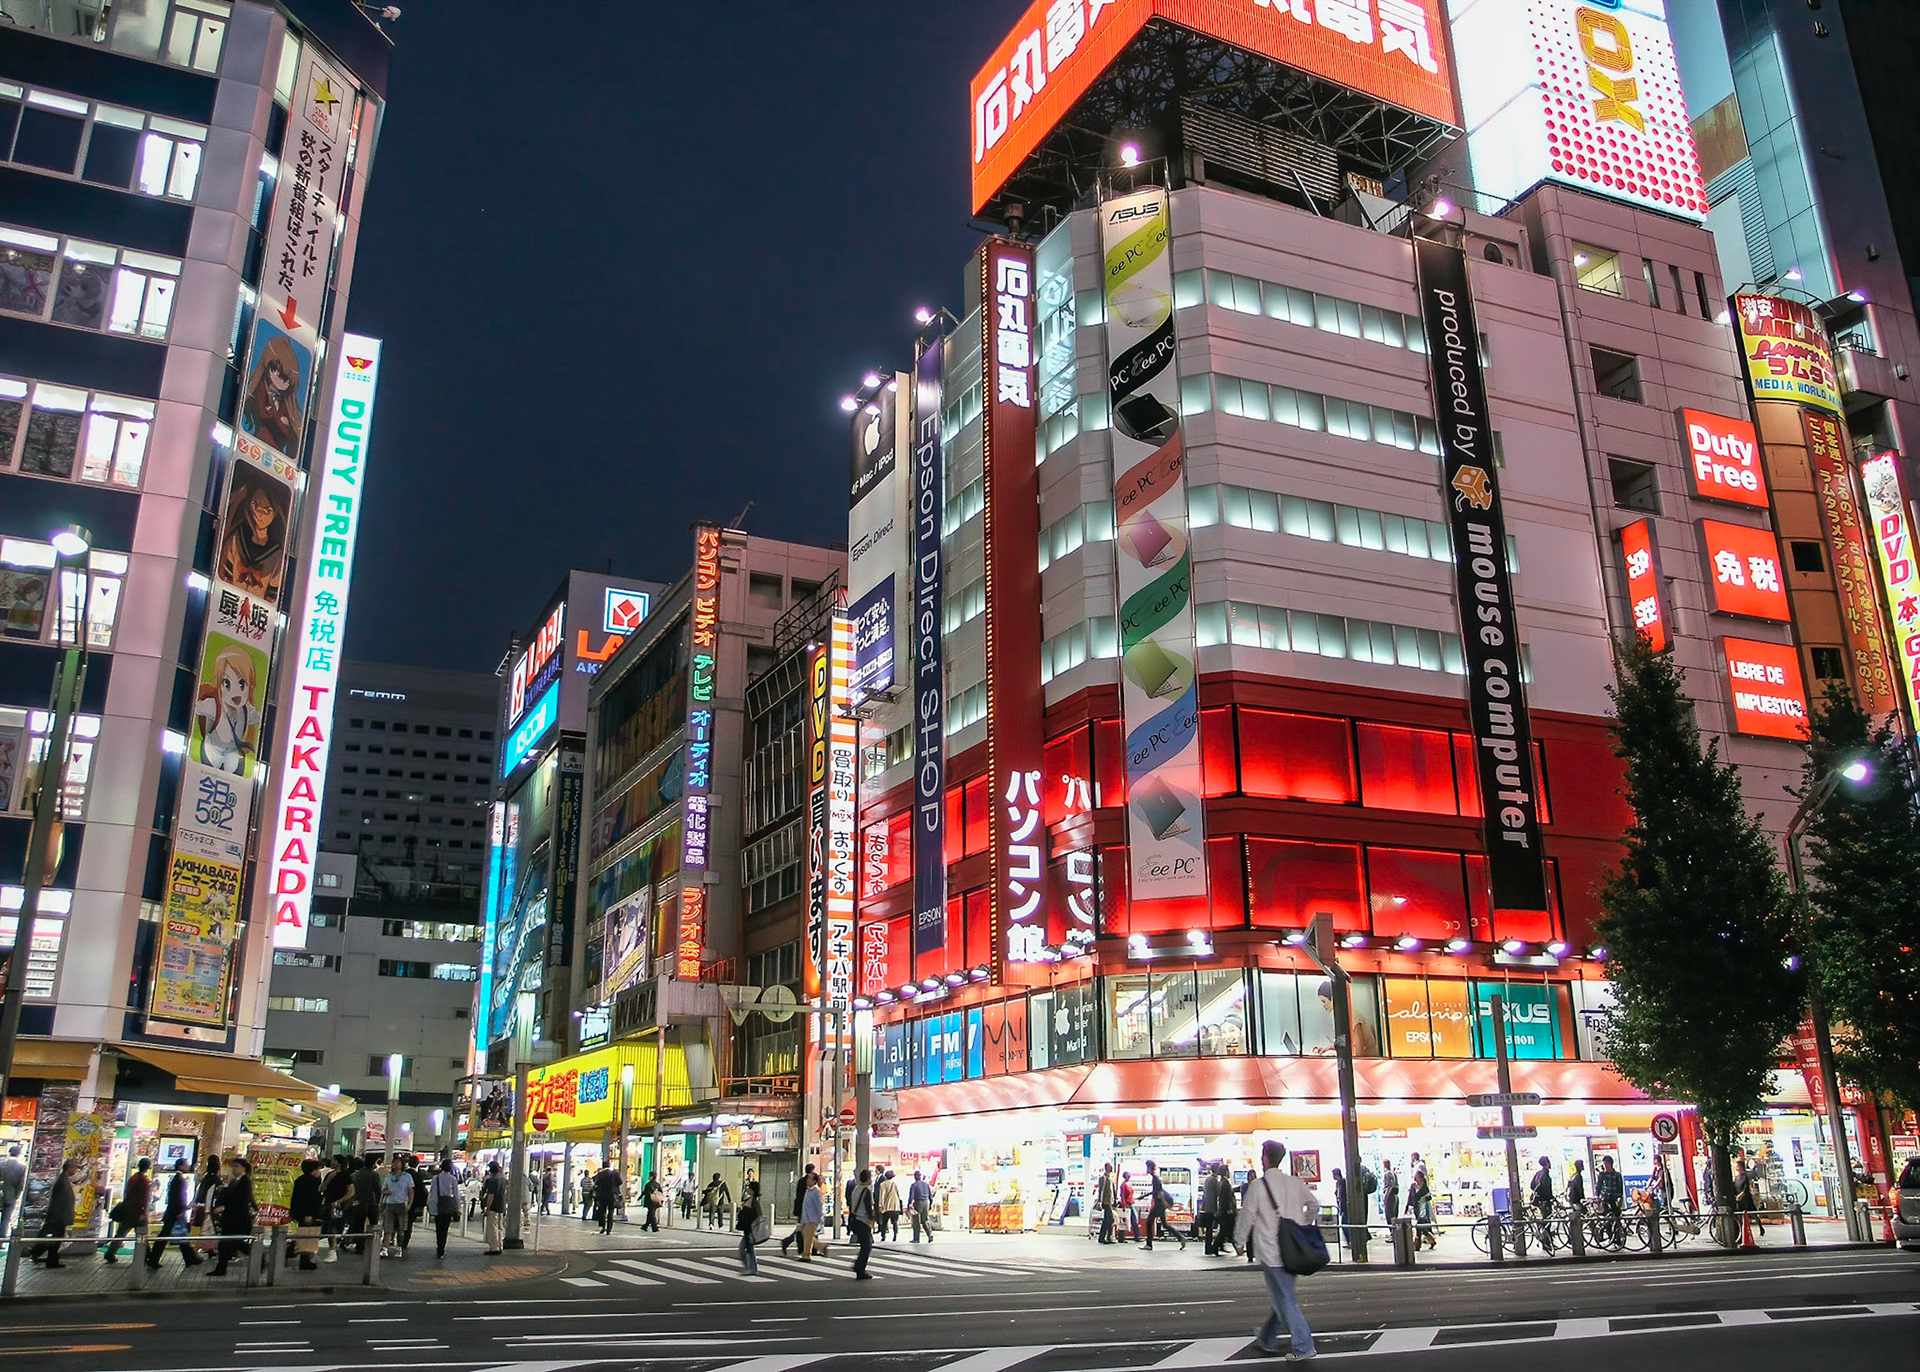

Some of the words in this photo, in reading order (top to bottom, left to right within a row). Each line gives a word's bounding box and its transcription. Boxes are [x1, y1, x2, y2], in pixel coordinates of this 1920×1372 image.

[1575, 0, 1646, 135] OX
[279, 129, 315, 293] 秋の新番組はこれだ
[303, 141, 333, 278] スターチャイルド
[1110, 202, 1159, 221] ASUS
[996, 258, 1031, 408] 石丸電気
[1433, 287, 1476, 416] produced
[1111, 369, 1129, 391] PC
[1131, 351, 1157, 376] Eee
[1755, 379, 1794, 391] MEDIA
[1798, 382, 1827, 399] WORLD
[1768, 356, 1836, 392] ラムタラ
[332, 398, 365, 485] DUTY
[1453, 423, 1477, 458] by
[1688, 424, 1754, 463] Duty
[1808, 416, 1827, 456] ここが
[859, 470, 874, 490] Mac
[877, 448, 894, 473] iPod
[916, 412, 938, 541] Epson
[1137, 471, 1156, 492] PC
[1694, 453, 1758, 491] Free
[318, 494, 353, 580] FREE
[851, 535, 873, 564] Epson
[873, 519, 894, 545] Direct
[698, 531, 720, 591] パソコン
[1466, 522, 1505, 647] mouse
[1714, 550, 1780, 593] 免税
[1880, 514, 1908, 586] DVD
[1897, 595, 1919, 626] 本
[694, 596, 717, 647] ビデオ
[920, 550, 938, 678] Direct
[1121, 612, 1141, 635] PC
[1169, 576, 1190, 600] PC
[304, 590, 339, 672] 免税店
[526, 601, 564, 687] LABI
[576, 662, 604, 675] AK
[694, 654, 715, 701] テレビ
[1730, 660, 1766, 682] LIBRE
[1767, 664, 1785, 684] DE
[349, 688, 406, 702] remm
[812, 654, 827, 787] DVD
[1149, 728, 1170, 751] PC
[1172, 709, 1199, 736] Eee
[564, 761, 583, 770] LABI
[688, 709, 712, 788] オーディオ
[919, 687, 940, 832] SHOP
[1481, 658, 1530, 849] computer
[199, 775, 238, 807] 今日の
[832, 749, 852, 802] 買取り
[195, 798, 234, 832] 5の2
[276, 685, 330, 928] TAKARADA
[685, 795, 707, 866] 電化製品
[172, 870, 236, 895] ゲーマーズ本店
[174, 858, 239, 883] AKIHABARA
[834, 831, 849, 895] まっくす
[1005, 770, 1049, 963] パソコン館
[1138, 854, 1170, 877] Eee
[1174, 857, 1195, 875] PC
[679, 885, 704, 979] ラジオ会館
[919, 906, 941, 926] EPSON
[1479, 1002, 1551, 1024] PXUS
[1406, 1031, 1443, 1043] EPSON
[1505, 1034, 1535, 1045] anon
